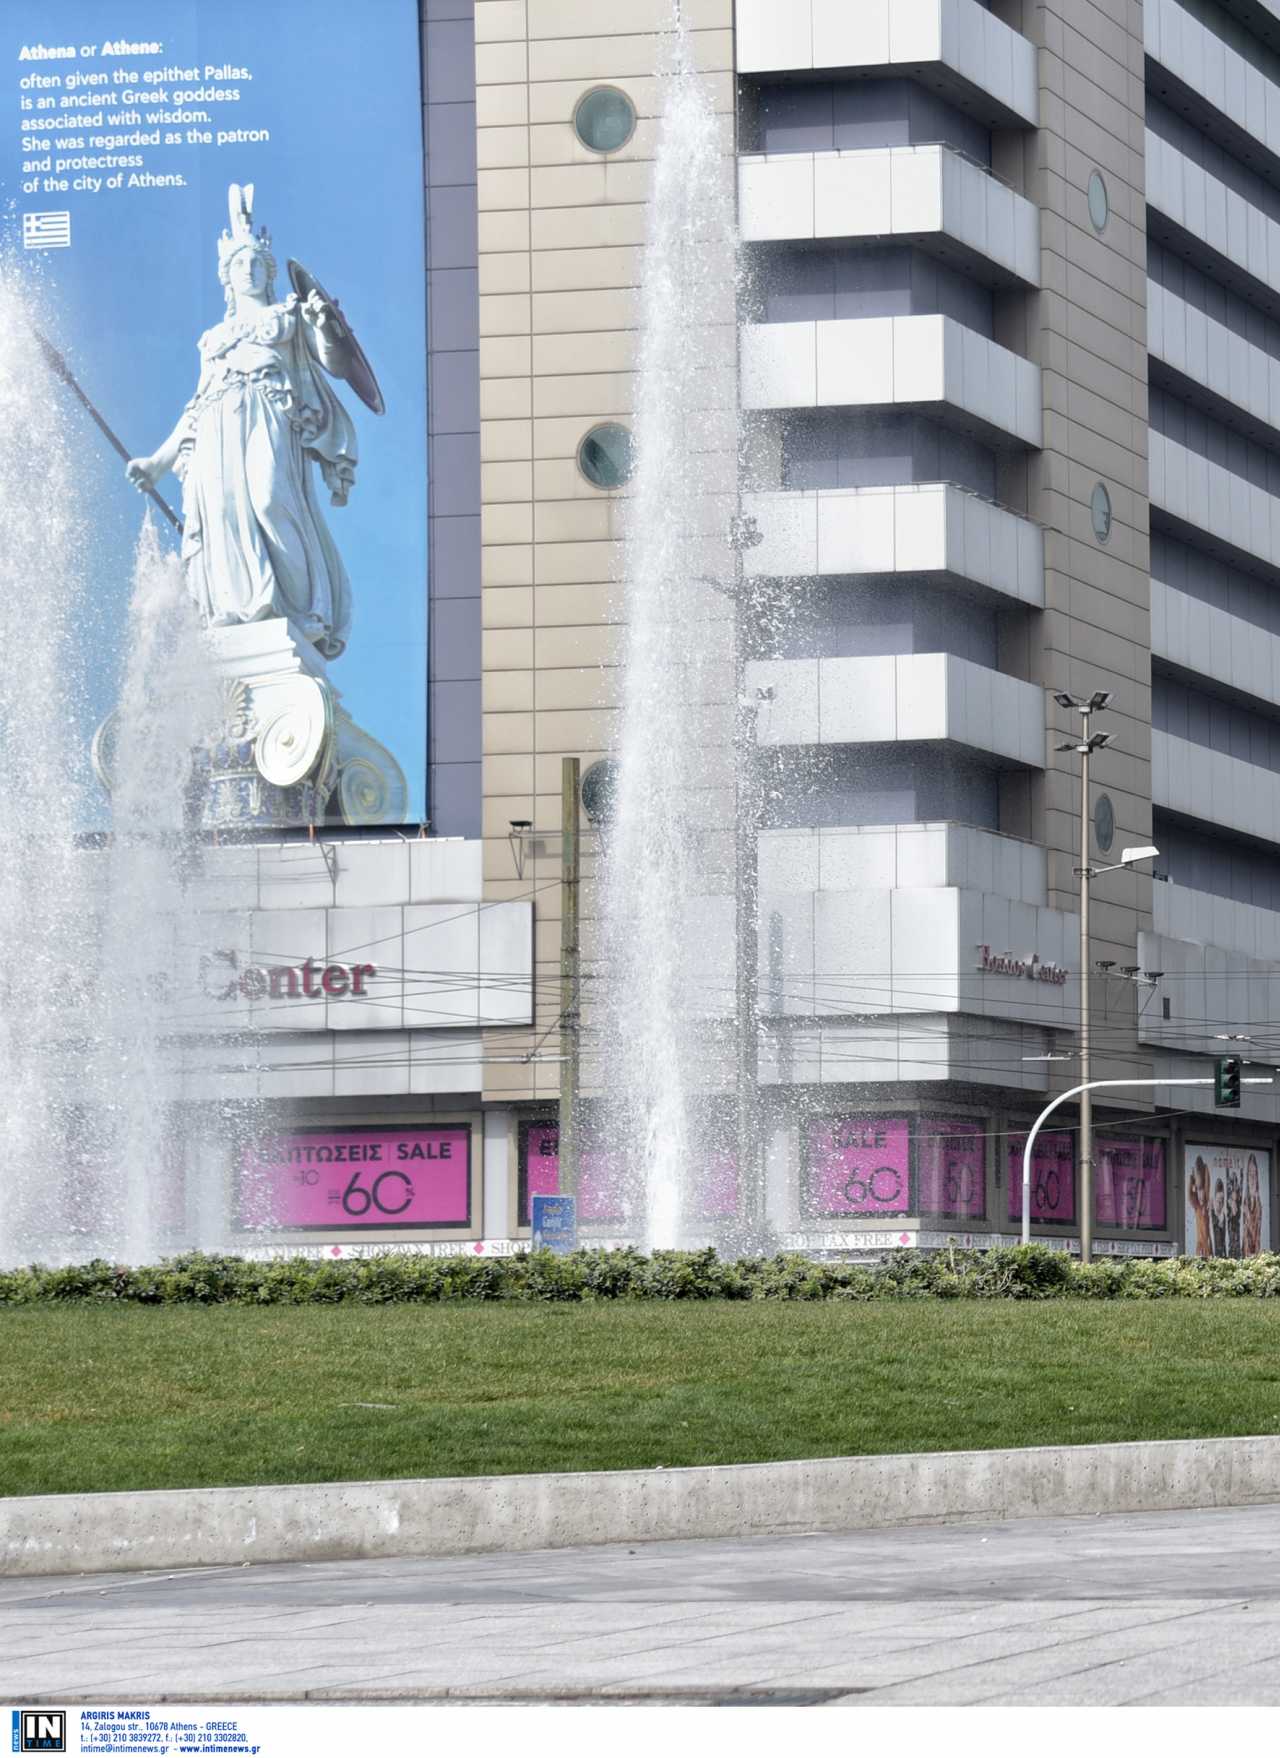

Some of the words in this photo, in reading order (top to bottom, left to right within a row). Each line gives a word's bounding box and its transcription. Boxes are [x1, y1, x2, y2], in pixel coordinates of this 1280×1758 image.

[19, 44, 76, 60] Athena
[80, 45, 97, 57] or
[101, 40, 163, 56] Athene:
[20, 73, 61, 89] often
[65, 70, 108, 90] given
[113, 68, 139, 84] the
[143, 65, 200, 85] epithet
[204, 64, 253, 80] Pallas,
[21, 95, 32, 110] is
[37, 96, 55, 109] an
[60, 91, 117, 108] ancient
[122, 89, 169, 104] Greek
[173, 85, 241, 105] goddess
[21, 111, 103, 130] associated
[108, 109, 141, 125] with
[146, 108, 212, 123] wisdom.
[22, 136, 51, 151] She
[56, 137, 84, 149] was
[89, 130, 160, 150] regarded
[165, 132, 182, 144] as
[187, 128, 212, 143] the
[217, 128, 269, 146] patron
[23, 156, 50, 172] and
[56, 154, 143, 173] protectress
[23, 177, 39, 193] of
[43, 176, 69, 192] the
[73, 175, 101, 192] city
[106, 172, 123, 188] of
[128, 171, 187, 187] Athens.
[397, 1142, 453, 1160] SALE
